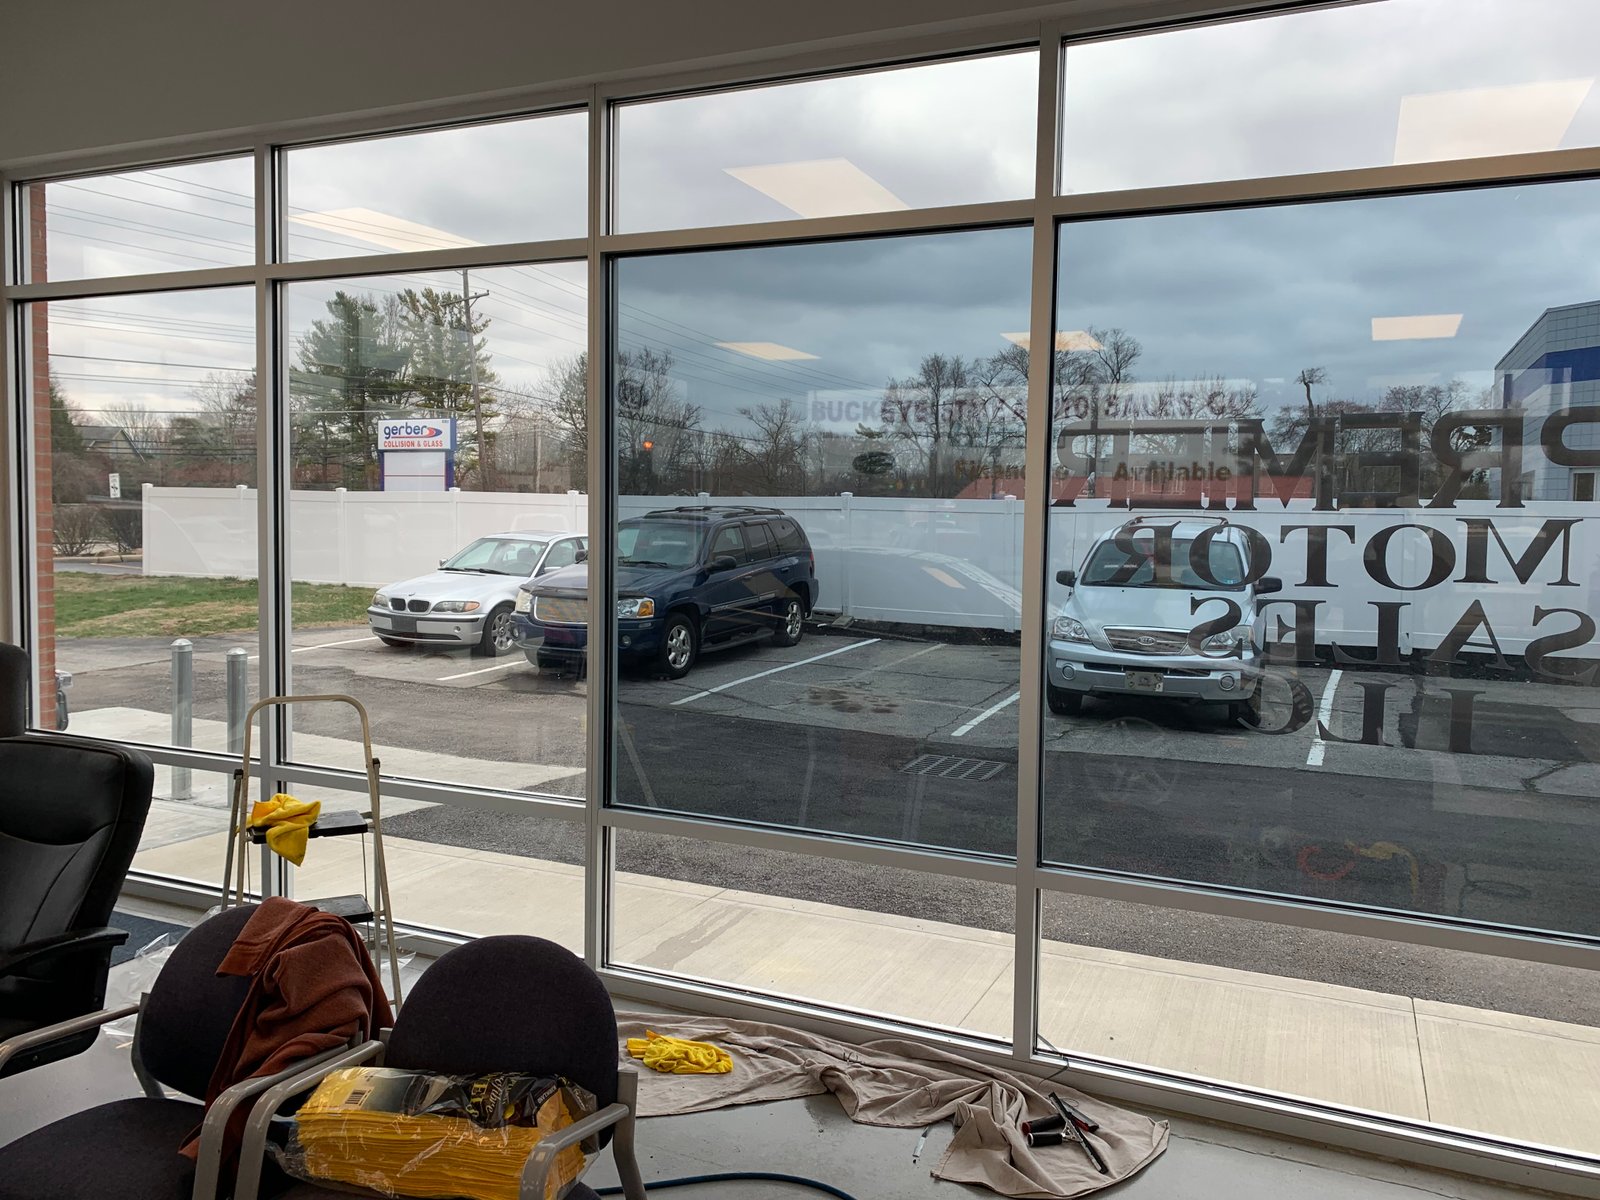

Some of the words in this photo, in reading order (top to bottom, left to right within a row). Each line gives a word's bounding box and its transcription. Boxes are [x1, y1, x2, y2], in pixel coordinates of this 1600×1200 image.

[384, 422, 427, 439] gerber
[383, 440, 414, 448] COLLISION
[417, 440, 422, 448] &
[423, 440, 443, 448] GLASS
